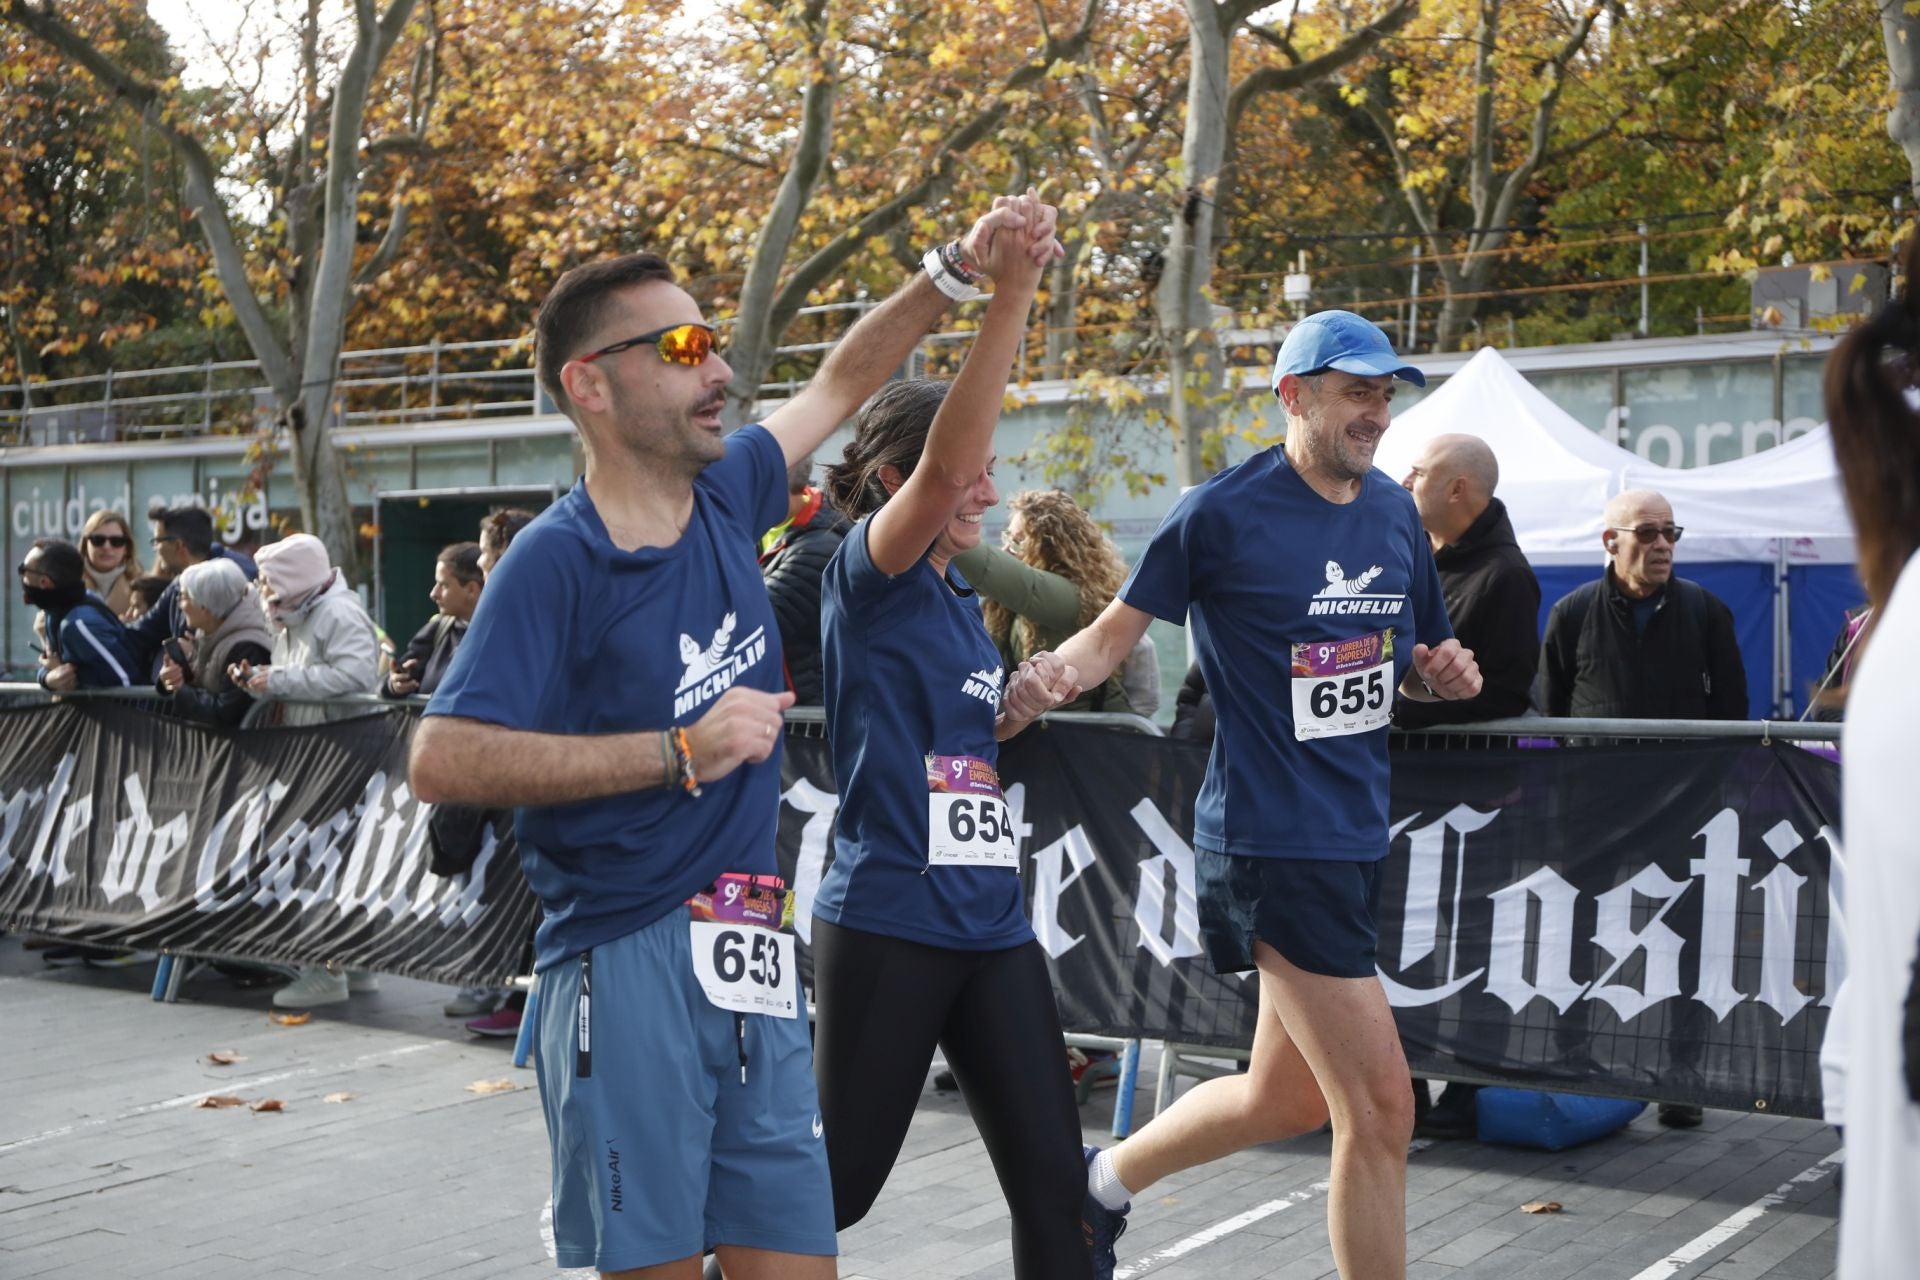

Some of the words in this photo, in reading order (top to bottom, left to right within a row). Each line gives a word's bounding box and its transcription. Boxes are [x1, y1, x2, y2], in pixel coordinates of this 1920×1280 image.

[1307, 600, 1403, 616] MICHELIN
[1336, 647, 1371, 664] EMPRESAS
[1310, 670, 1385, 719] 655
[99, 771, 189, 914] de
[948, 798, 1015, 846] 654
[713, 930, 782, 990] 653
